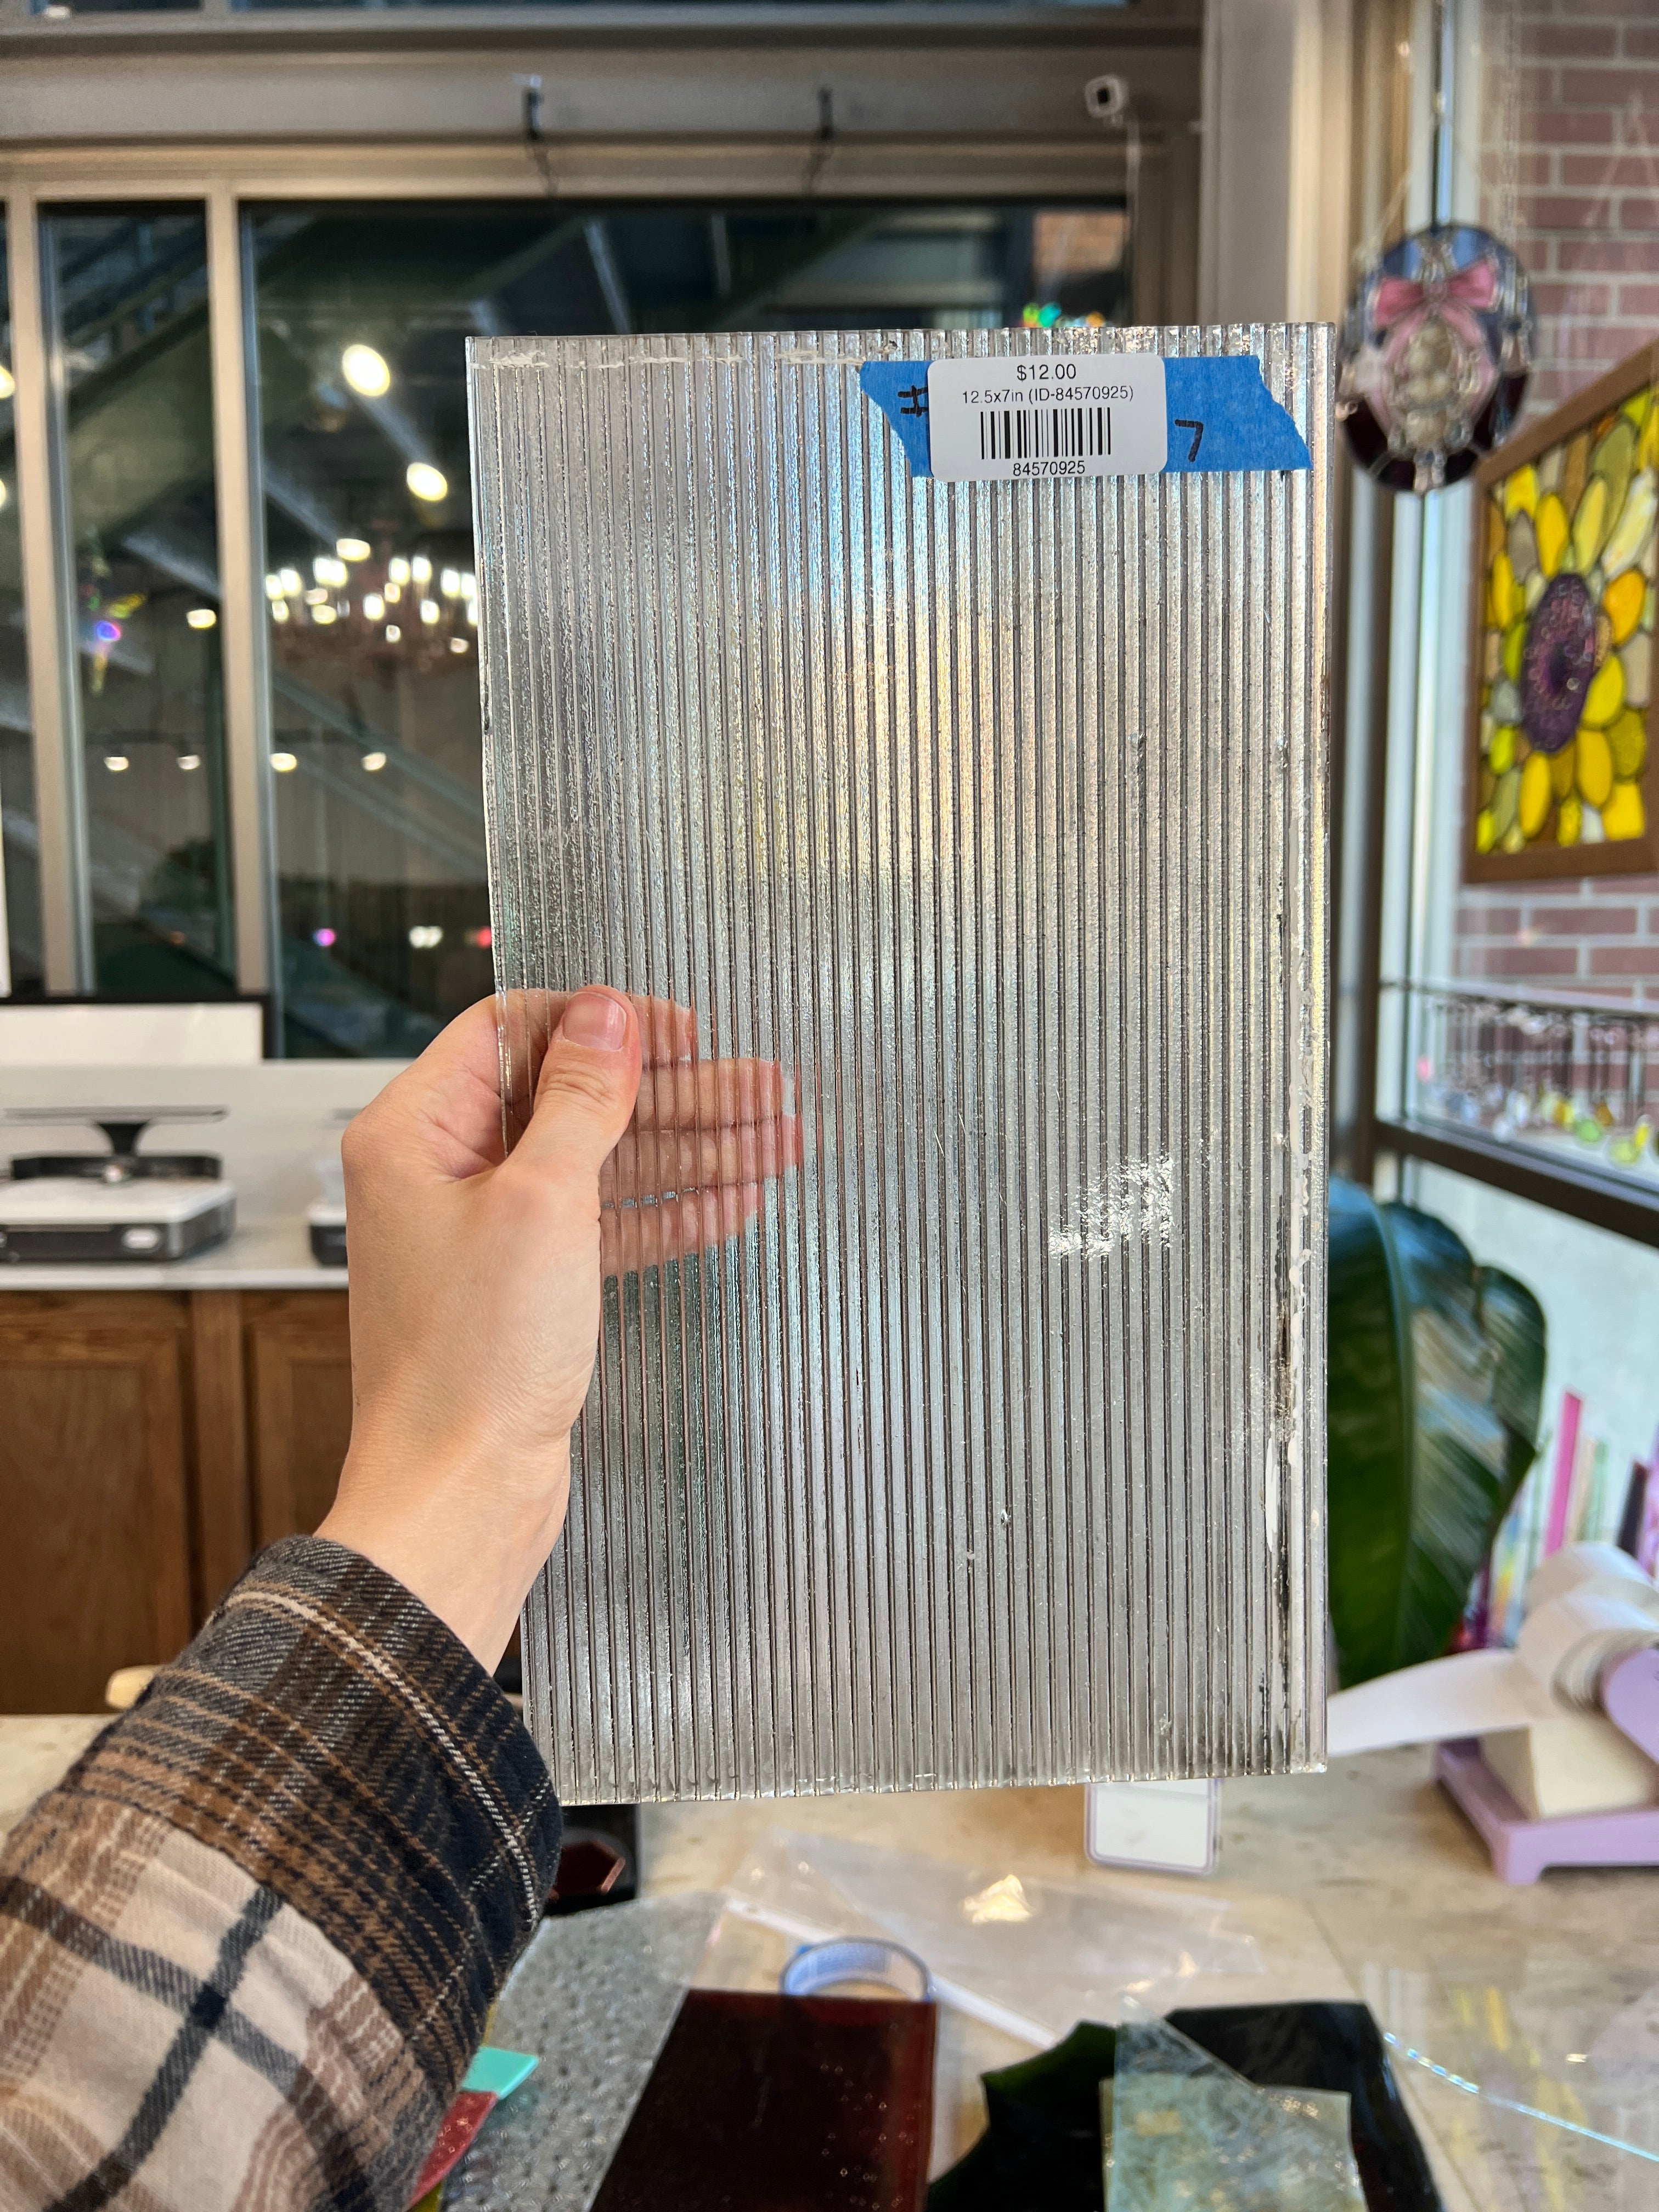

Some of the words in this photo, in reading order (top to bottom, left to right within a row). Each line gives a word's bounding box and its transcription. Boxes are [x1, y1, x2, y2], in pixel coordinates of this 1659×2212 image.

[1017, 363, 1076, 382] $12.00
[962, 389, 1023, 404] 12.5x7in
[1029, 385, 1133, 405] (ID-84570925)
[1013, 460, 1085, 476] 84570925
